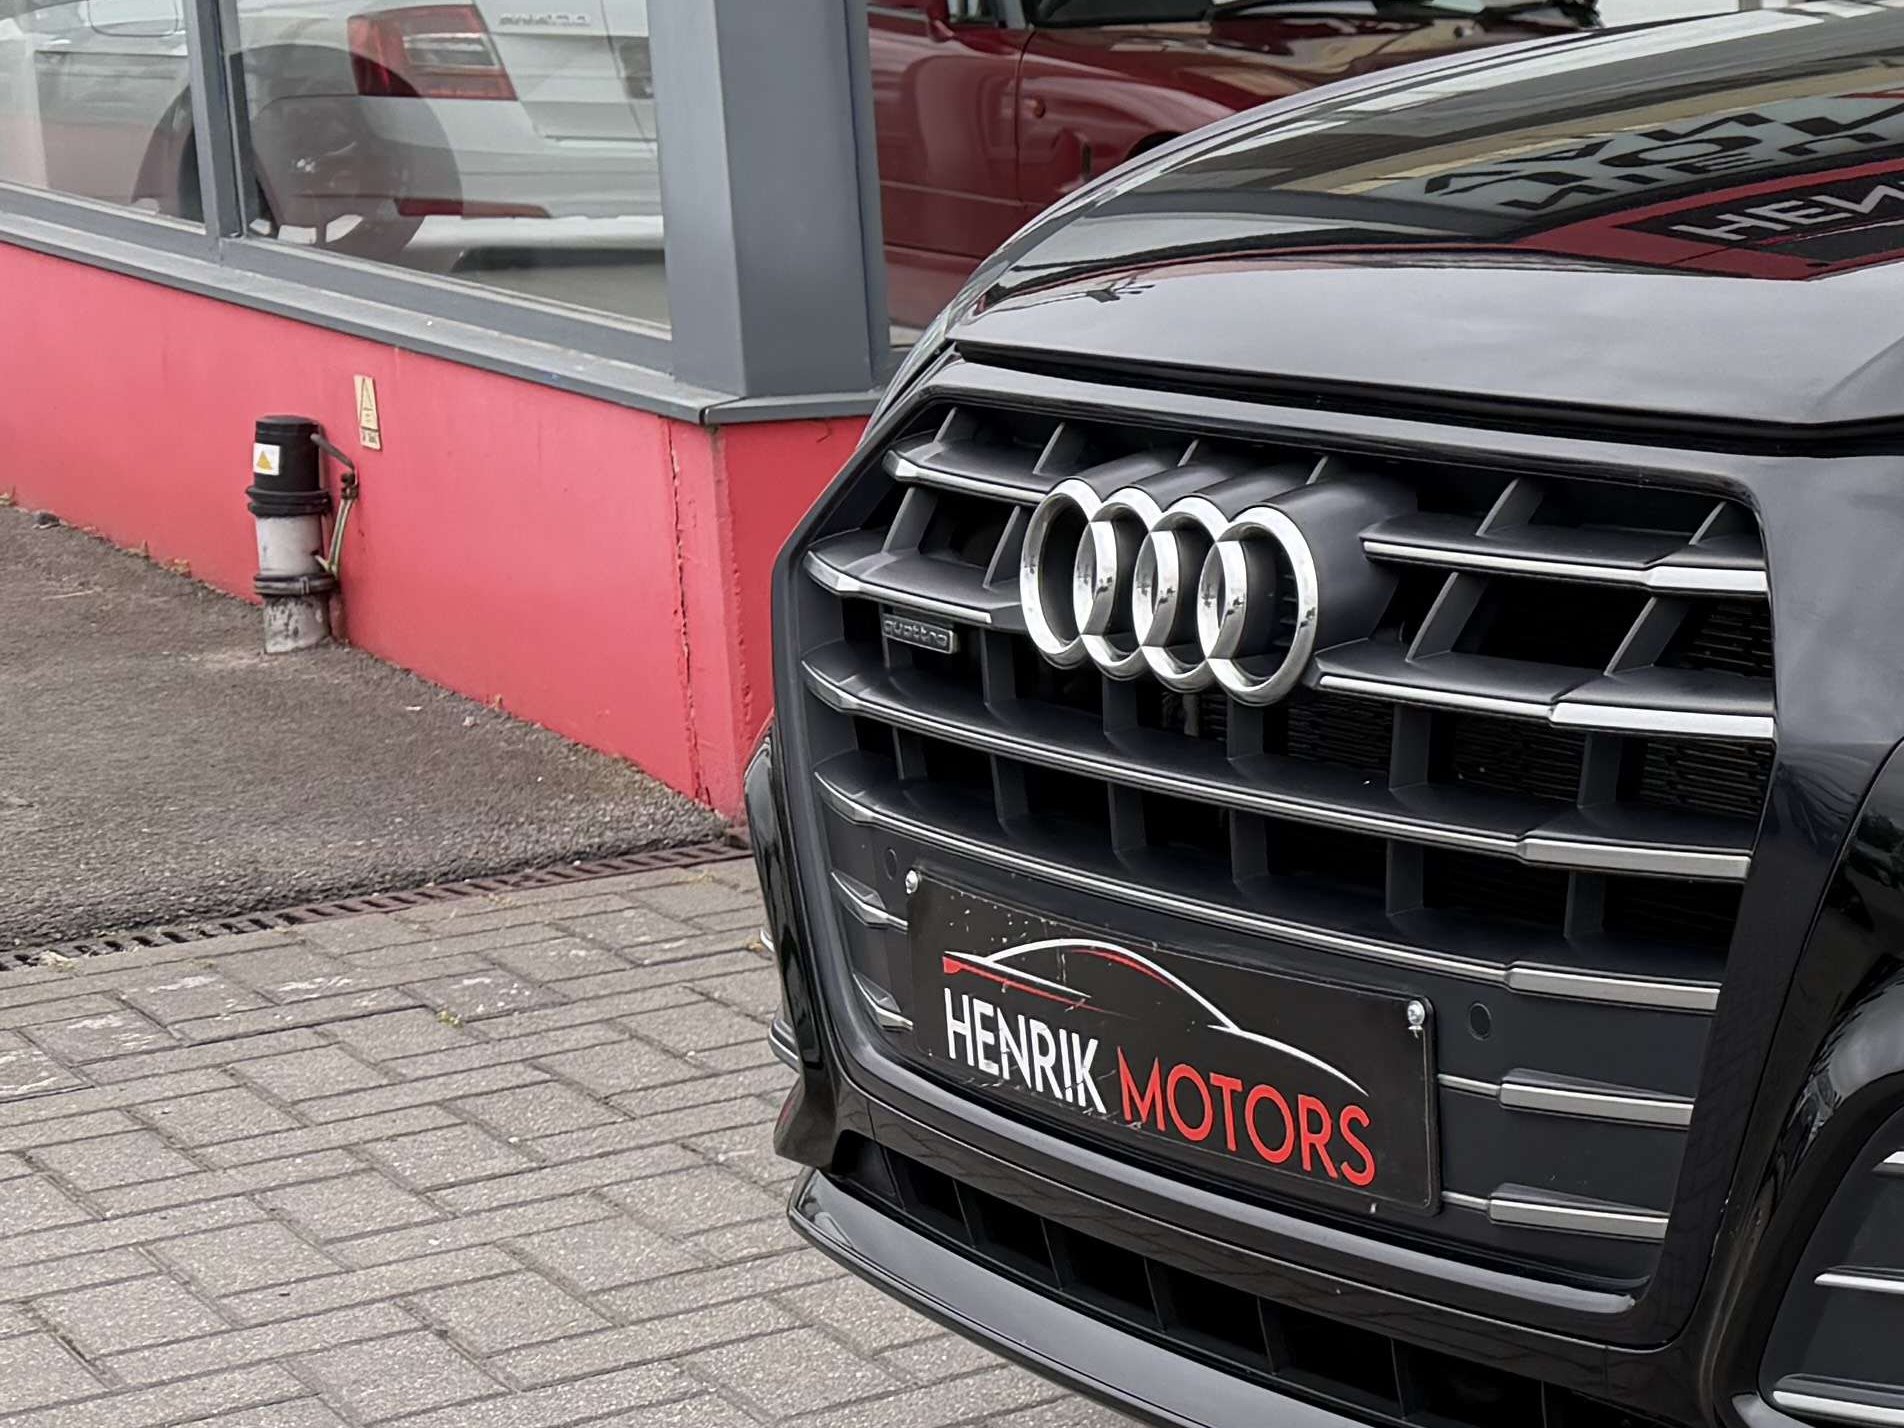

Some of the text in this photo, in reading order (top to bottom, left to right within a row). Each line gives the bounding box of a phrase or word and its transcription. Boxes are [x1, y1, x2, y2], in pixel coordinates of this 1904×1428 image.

[884, 619, 948, 647] quattro
[943, 988, 1375, 1186] HENRIK MOTORS
